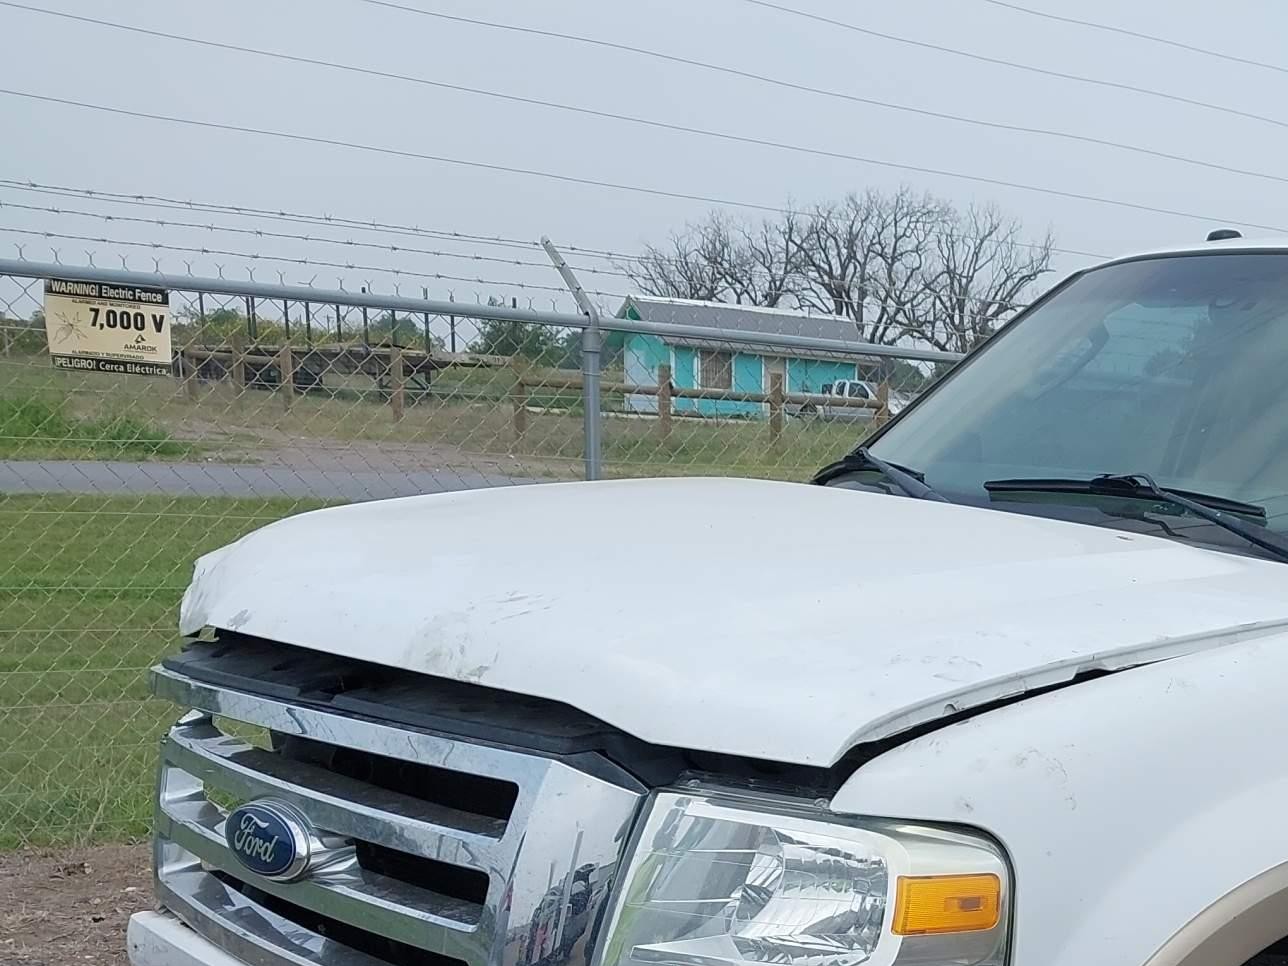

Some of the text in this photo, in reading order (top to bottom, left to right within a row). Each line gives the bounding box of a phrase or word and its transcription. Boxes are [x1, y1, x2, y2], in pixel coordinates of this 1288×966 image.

[51, 280, 162, 302] WARNING! Electric Fence
[89, 307, 165, 333] 7,000 V
[99, 361, 124, 371] Cerca
[234, 813, 279, 862] Ford
